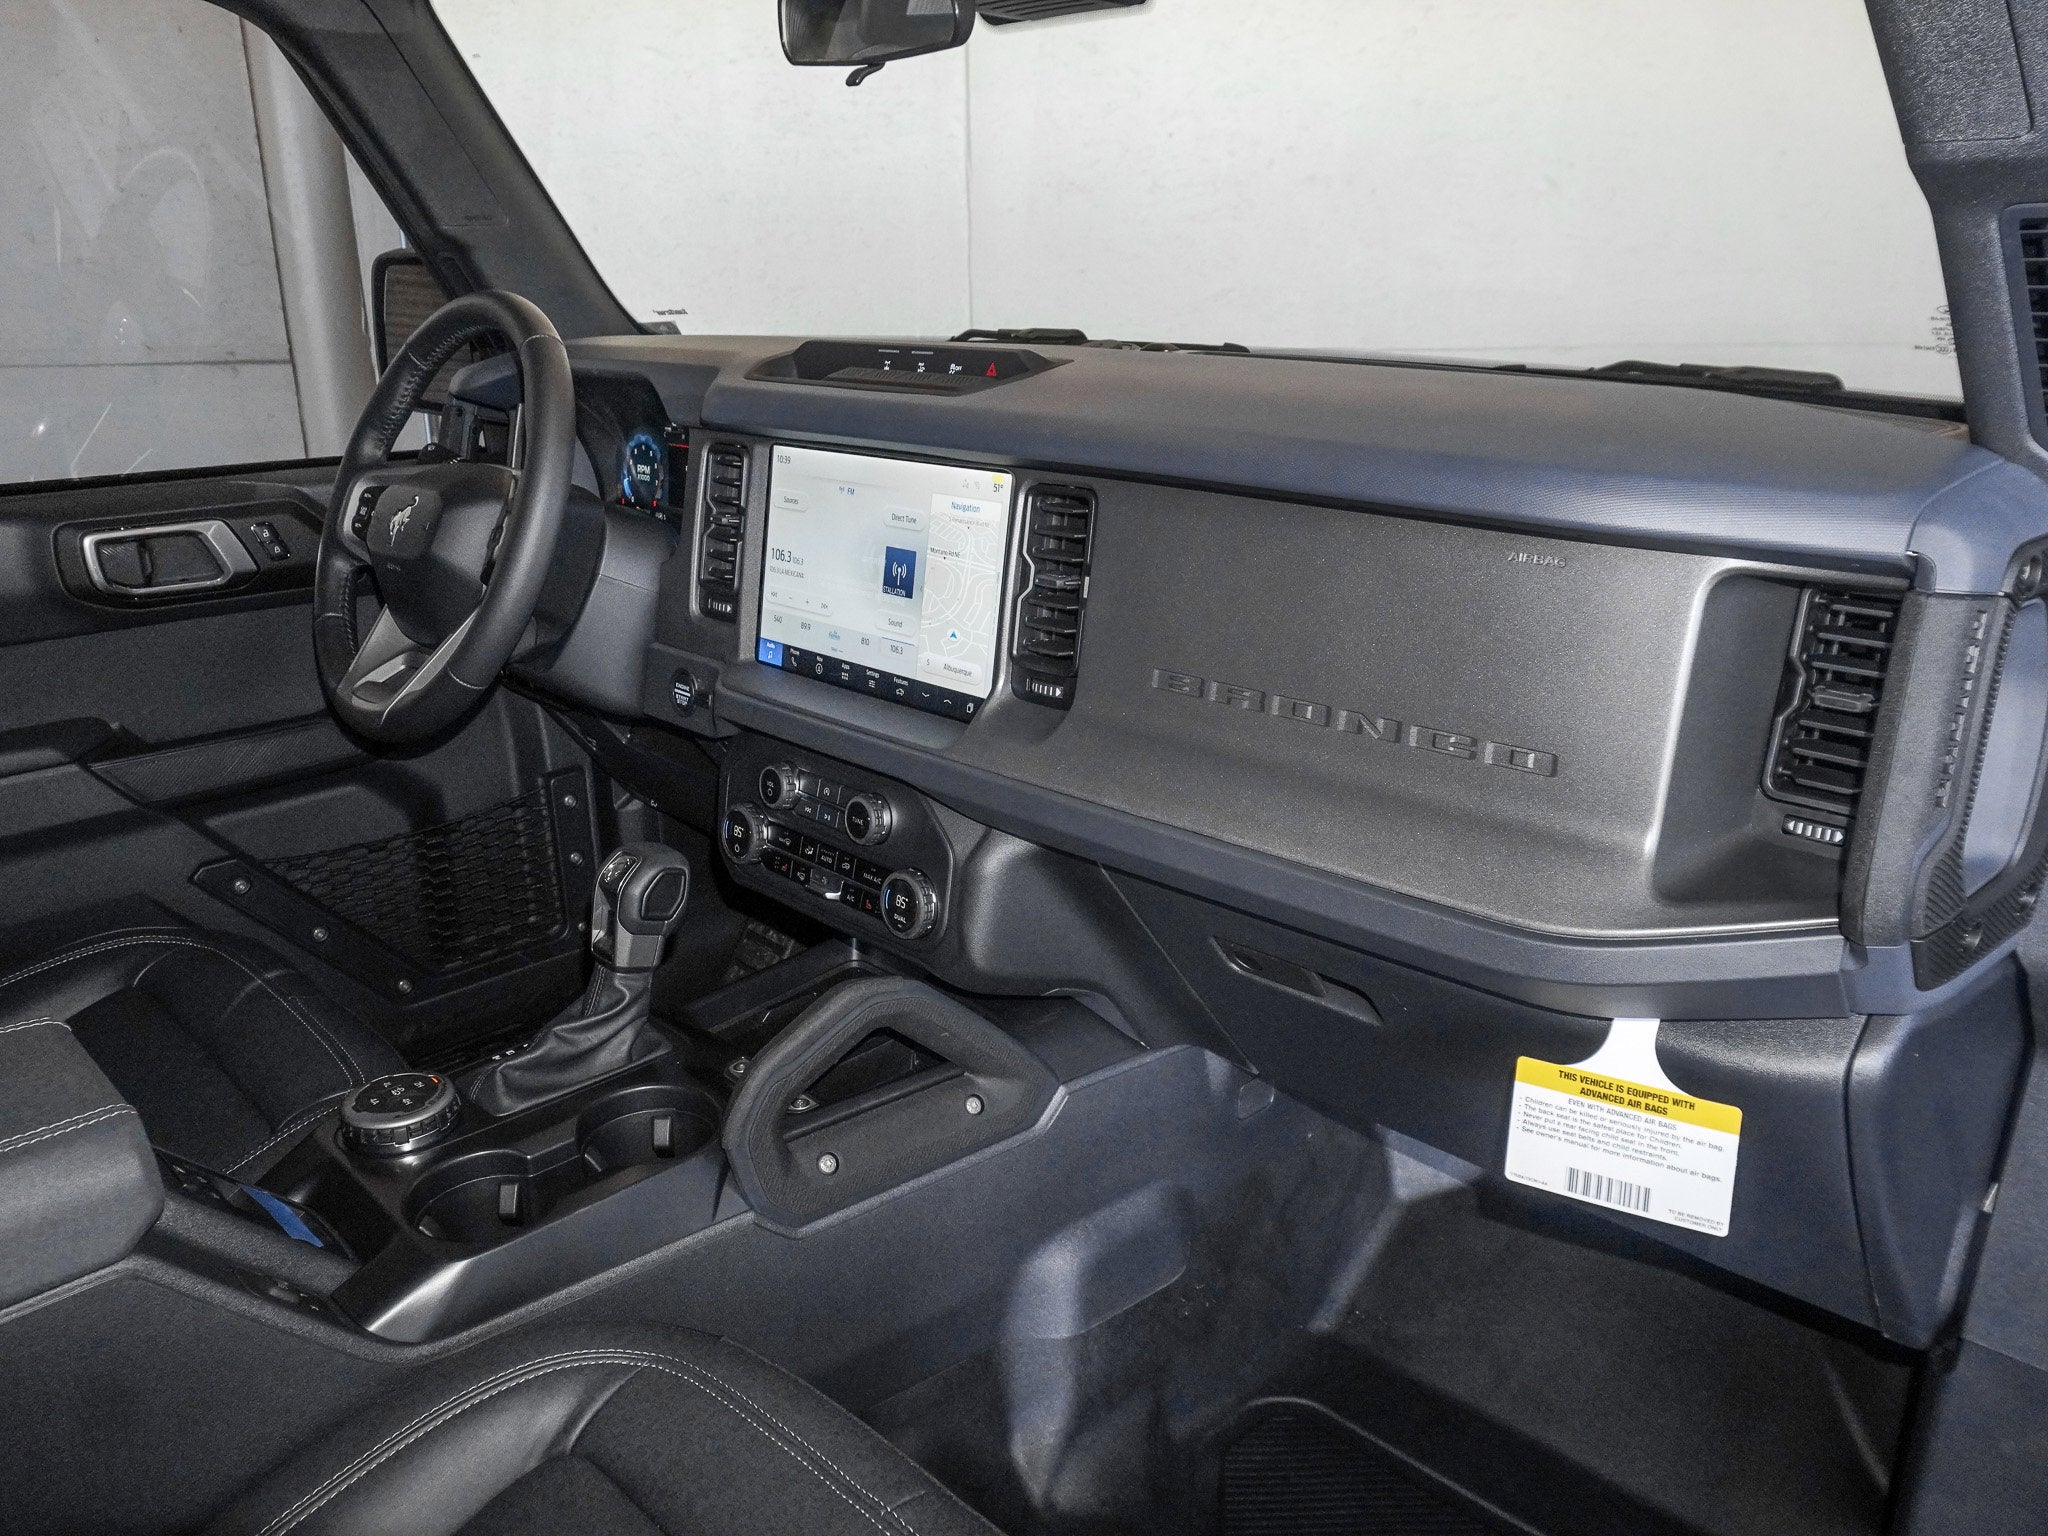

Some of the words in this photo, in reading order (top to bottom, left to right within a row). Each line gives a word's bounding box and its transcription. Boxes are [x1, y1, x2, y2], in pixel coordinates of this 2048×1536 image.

[777, 454, 791, 465] 10:39
[637, 464, 651, 474] RPM
[847, 487, 855, 496] FM
[951, 501, 980, 514] Navigation
[891, 512, 905, 523] Direct
[905, 516, 917, 524] Tune
[771, 547, 792, 563] 106.3
[1508, 552, 1566, 568] AIRBAG
[888, 617, 903, 628] Sound
[1152, 667, 1559, 777] BRONCO
[1559, 1070, 1578, 1081] THIS
[1580, 1075, 1614, 1090] VEHICLE
[1616, 1084, 1625, 1092] IS
[1628, 1087, 1670, 1104] EQUIPPED
[1673, 1098, 1695, 1110] WITH
[1526, 1096, 1553, 1108] Children
[1580, 1087, 1625, 1104] ADVANCED
[1628, 1098, 1642, 1108] AIR
[1645, 1103, 1668, 1115] BAGS
[1524, 1112, 1542, 1120] Never
[1539, 1107, 1553, 1115] back
[1569, 1098, 1585, 1107] EVEN
[1588, 1103, 1605, 1112] WITH
[1607, 1108, 1642, 1121] ADVANCED
[1645, 1117, 1656, 1125] AIR
[1659, 1121, 1677, 1130] BAGS
[1523, 1119, 1546, 1130] Always
